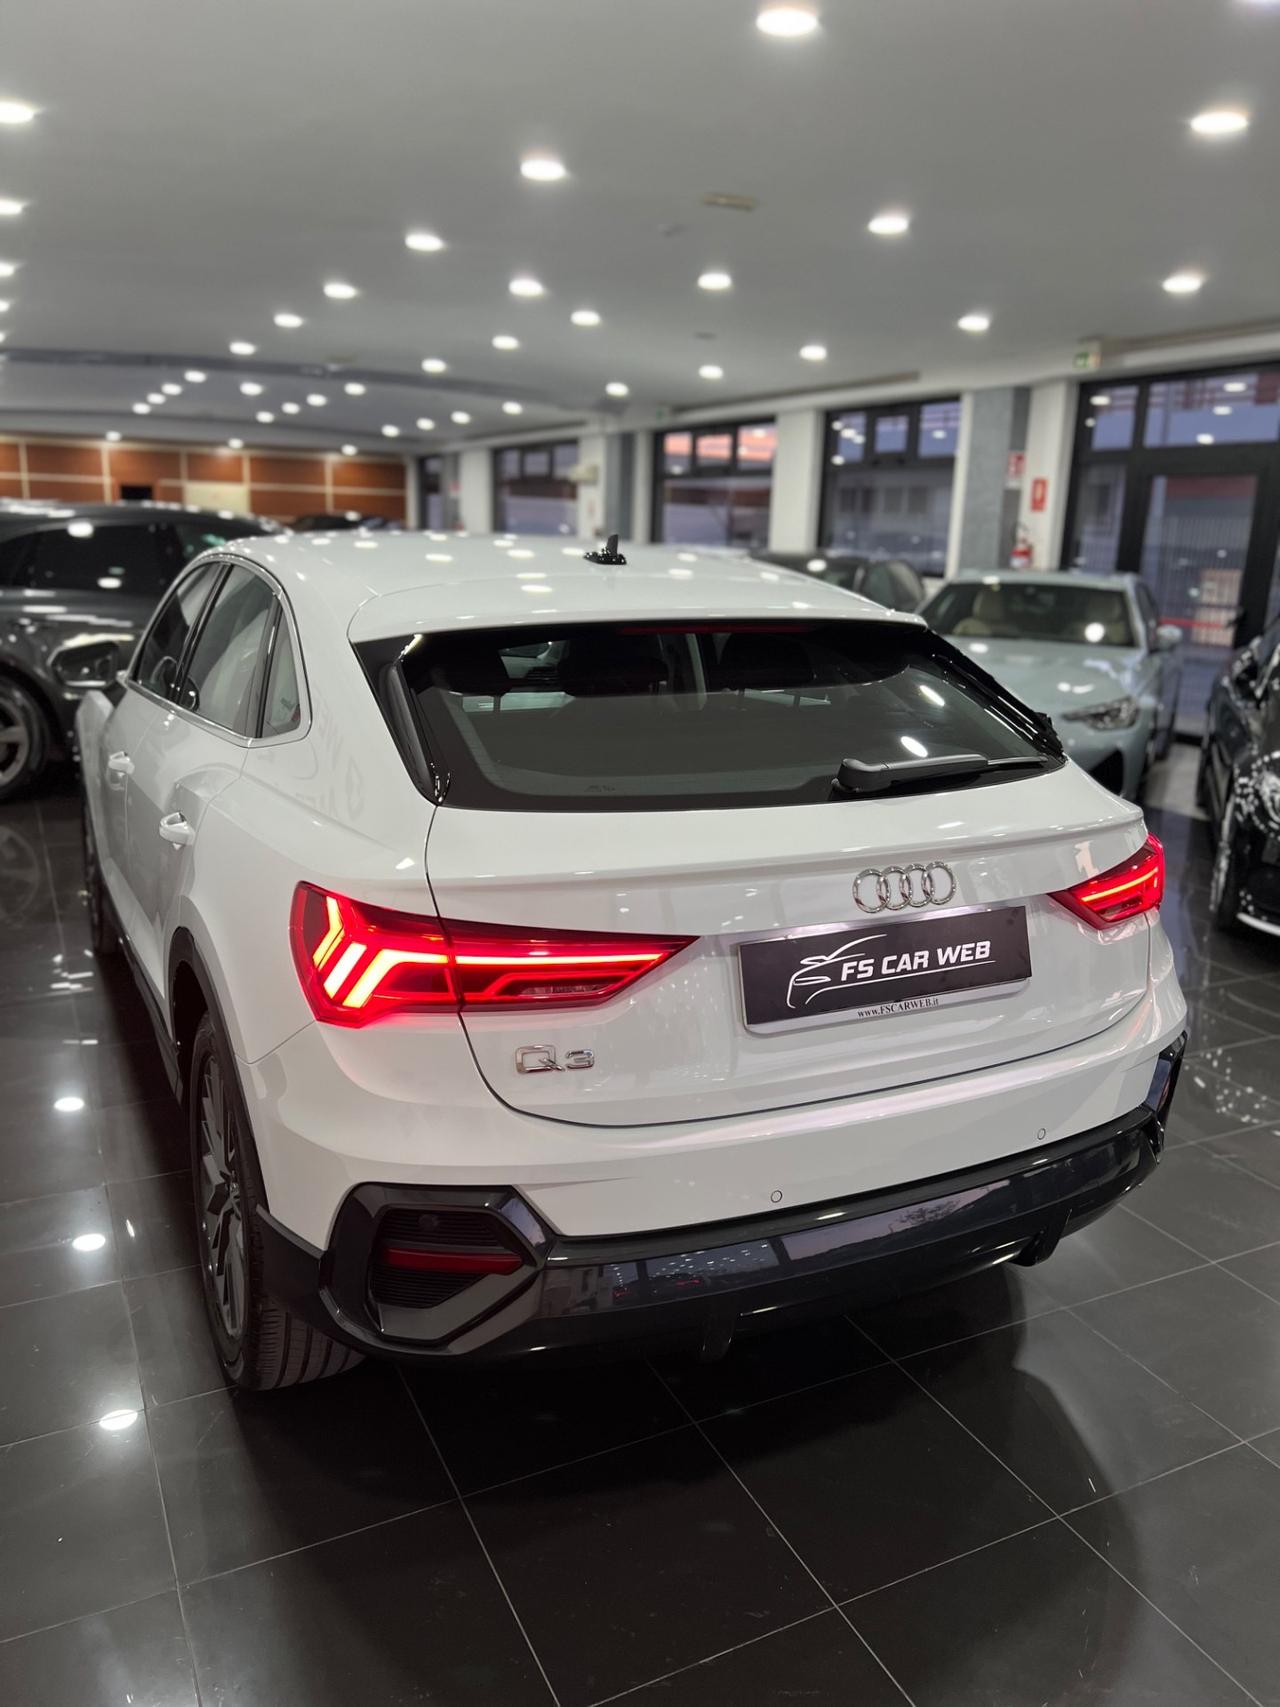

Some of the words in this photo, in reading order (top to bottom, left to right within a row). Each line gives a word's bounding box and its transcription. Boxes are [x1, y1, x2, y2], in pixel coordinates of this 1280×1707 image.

[841, 958, 875, 982] FS
[881, 950, 930, 975] CAR
[936, 940, 991, 966] WEB
[857, 998, 939, 1018] www.FSCARWEB.it
[515, 1044, 595, 1074] Q3
